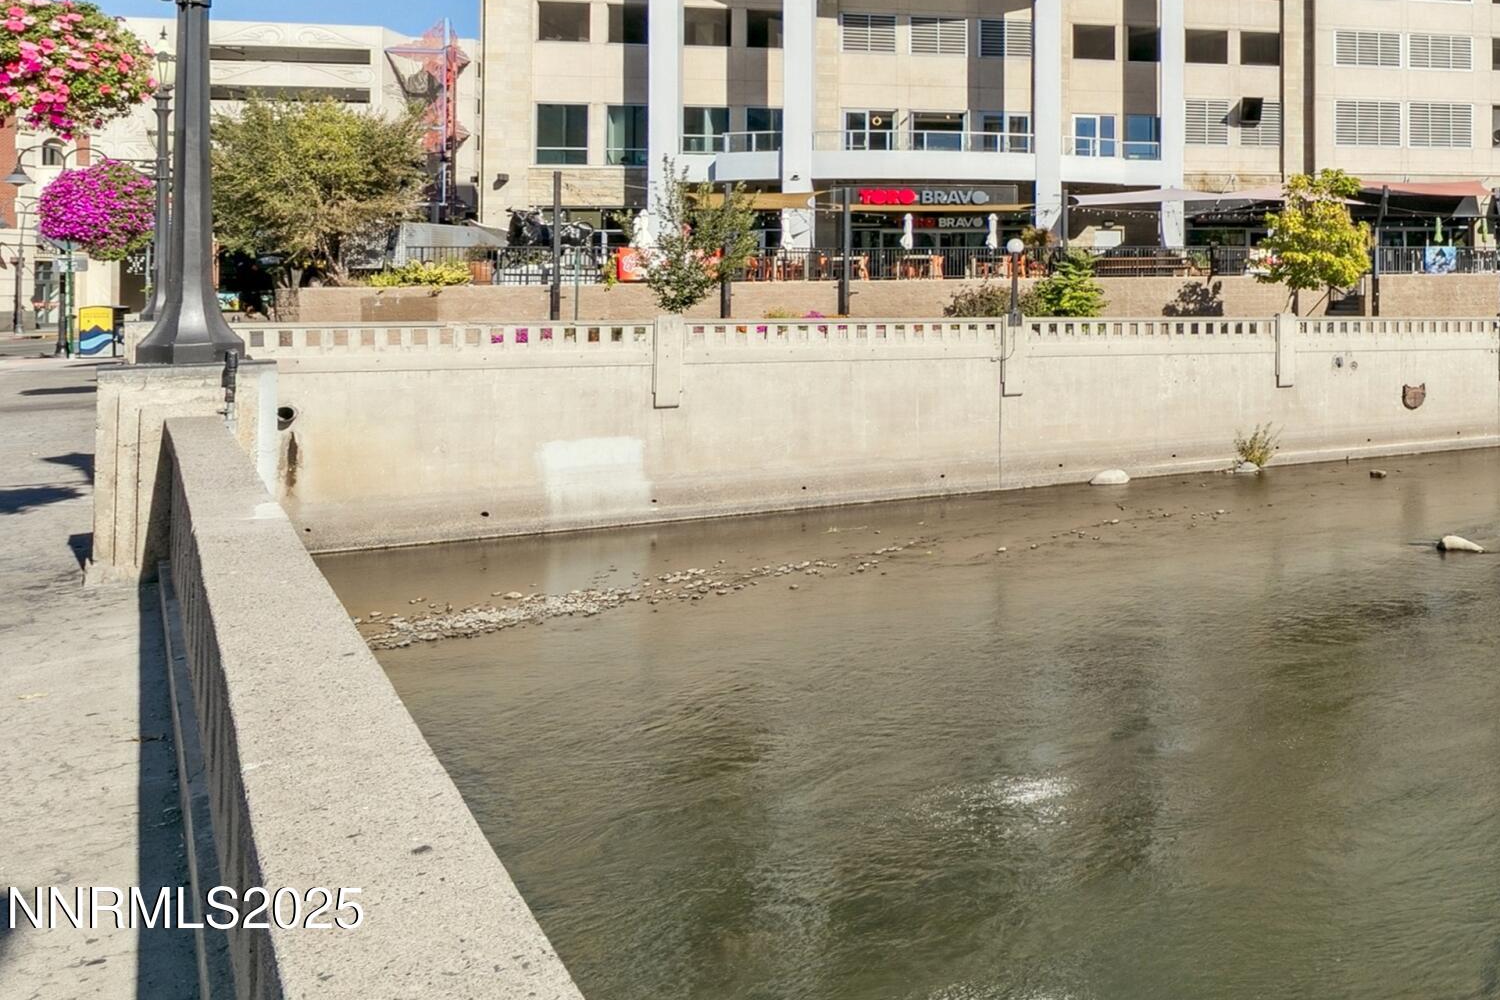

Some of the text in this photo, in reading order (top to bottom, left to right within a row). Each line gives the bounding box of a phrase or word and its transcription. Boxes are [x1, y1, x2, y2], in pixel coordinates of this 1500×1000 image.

[859, 188, 990, 206] TORO BRAVO
[937, 216, 984, 228] BRAVO
